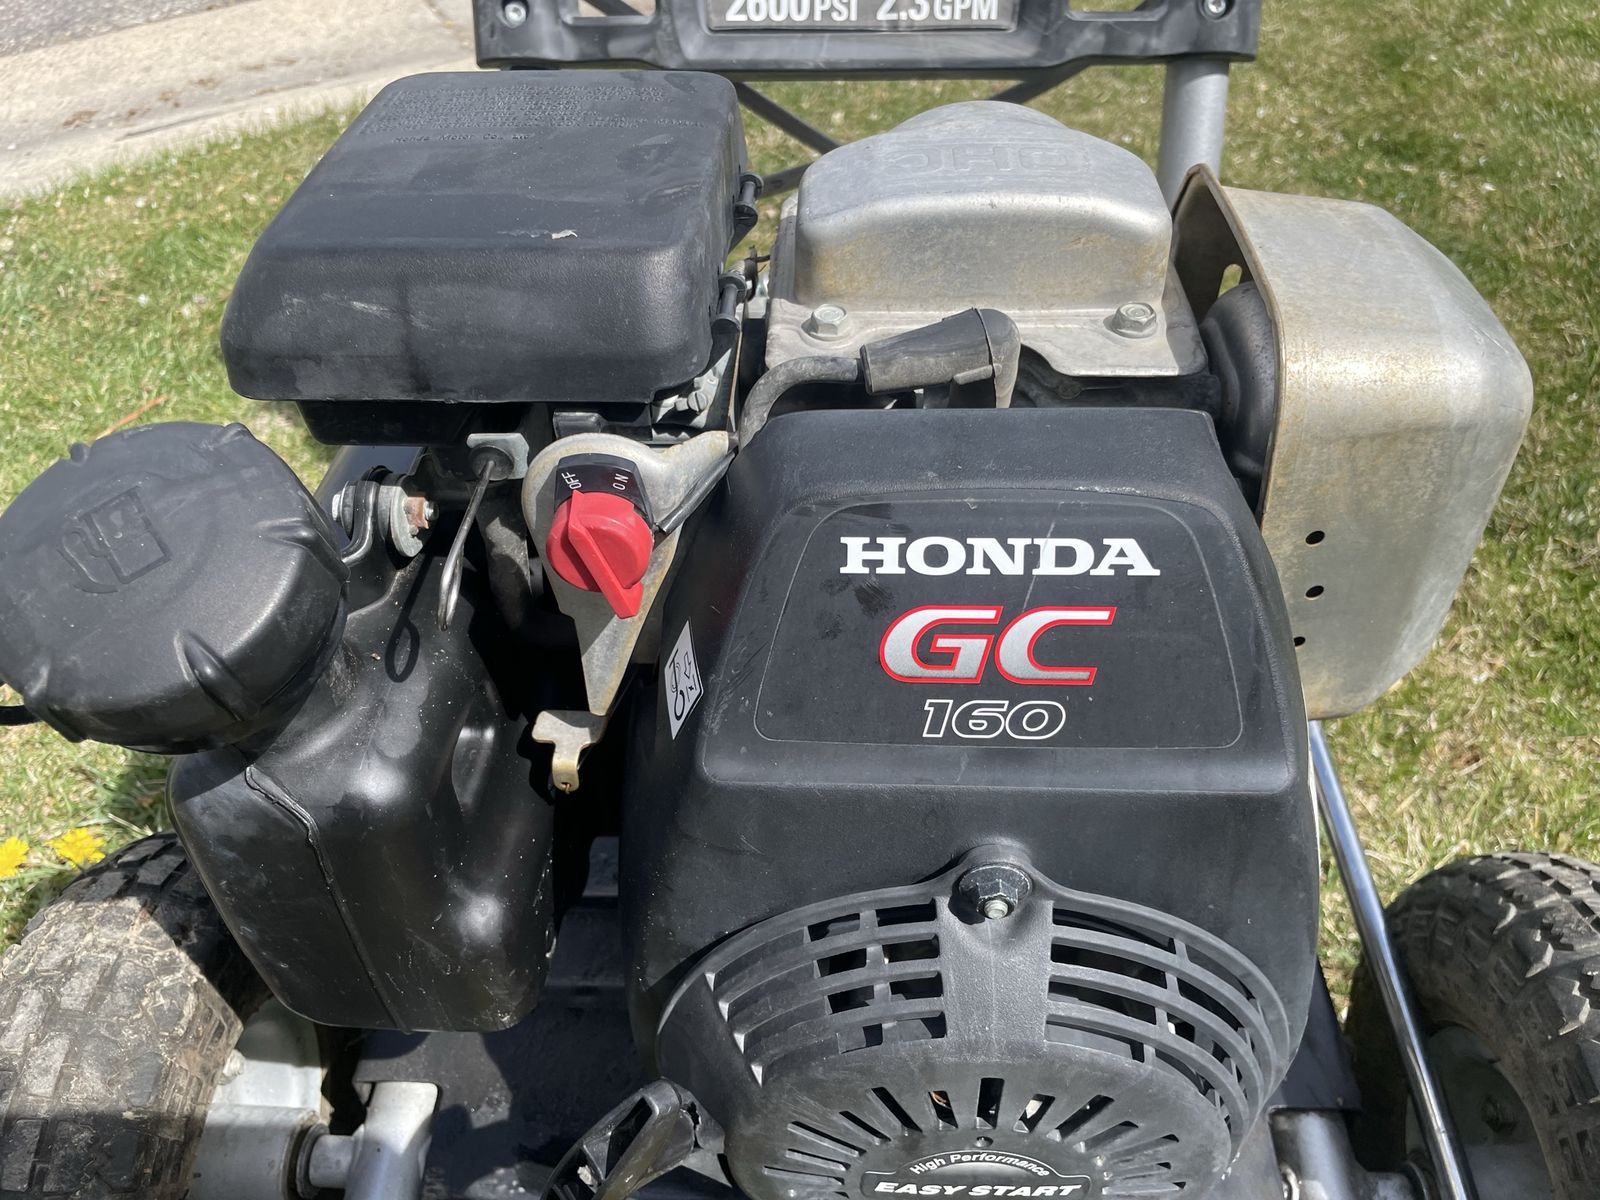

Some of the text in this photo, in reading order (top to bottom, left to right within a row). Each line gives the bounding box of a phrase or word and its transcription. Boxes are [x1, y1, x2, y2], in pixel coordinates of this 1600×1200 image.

[725, 0, 811, 22] 2600
[813, 0, 858, 22] PSI
[933, 0, 999, 21] GPM
[561, 472, 582, 490] OFF
[612, 473, 629, 491] ON
[839, 535, 1161, 577] HONDA
[879, 604, 1118, 686] GC
[921, 698, 1067, 740] 160
[909, 1152, 1050, 1178] High Performance
[874, 1181, 1082, 1197] EASY START
